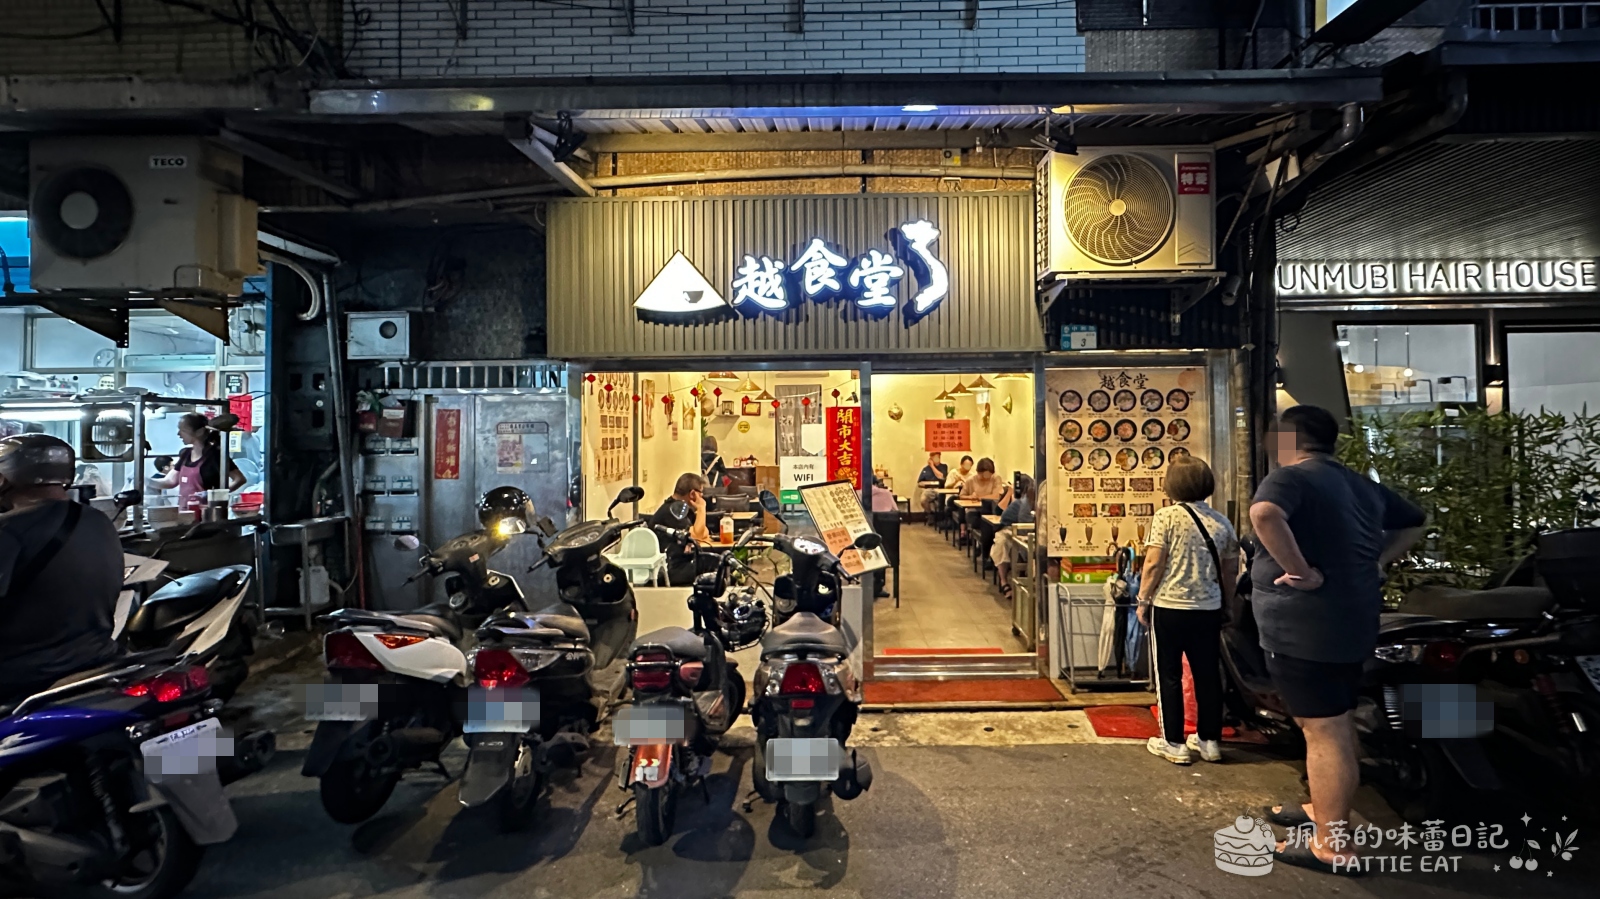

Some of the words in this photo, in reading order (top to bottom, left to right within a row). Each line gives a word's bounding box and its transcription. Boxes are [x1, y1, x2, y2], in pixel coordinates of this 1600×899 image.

[152, 157, 185, 167] TECO
[731, 237, 904, 311] 越食堂
[1408, 262, 1483, 290] HAIR
[1492, 260, 1598, 288] HOUSE
[1080, 338, 1087, 347] 3
[1099, 371, 1150, 391] 越食堂
[836, 408, 854, 466] 開市大吉
[793, 473, 814, 482] WIFI
